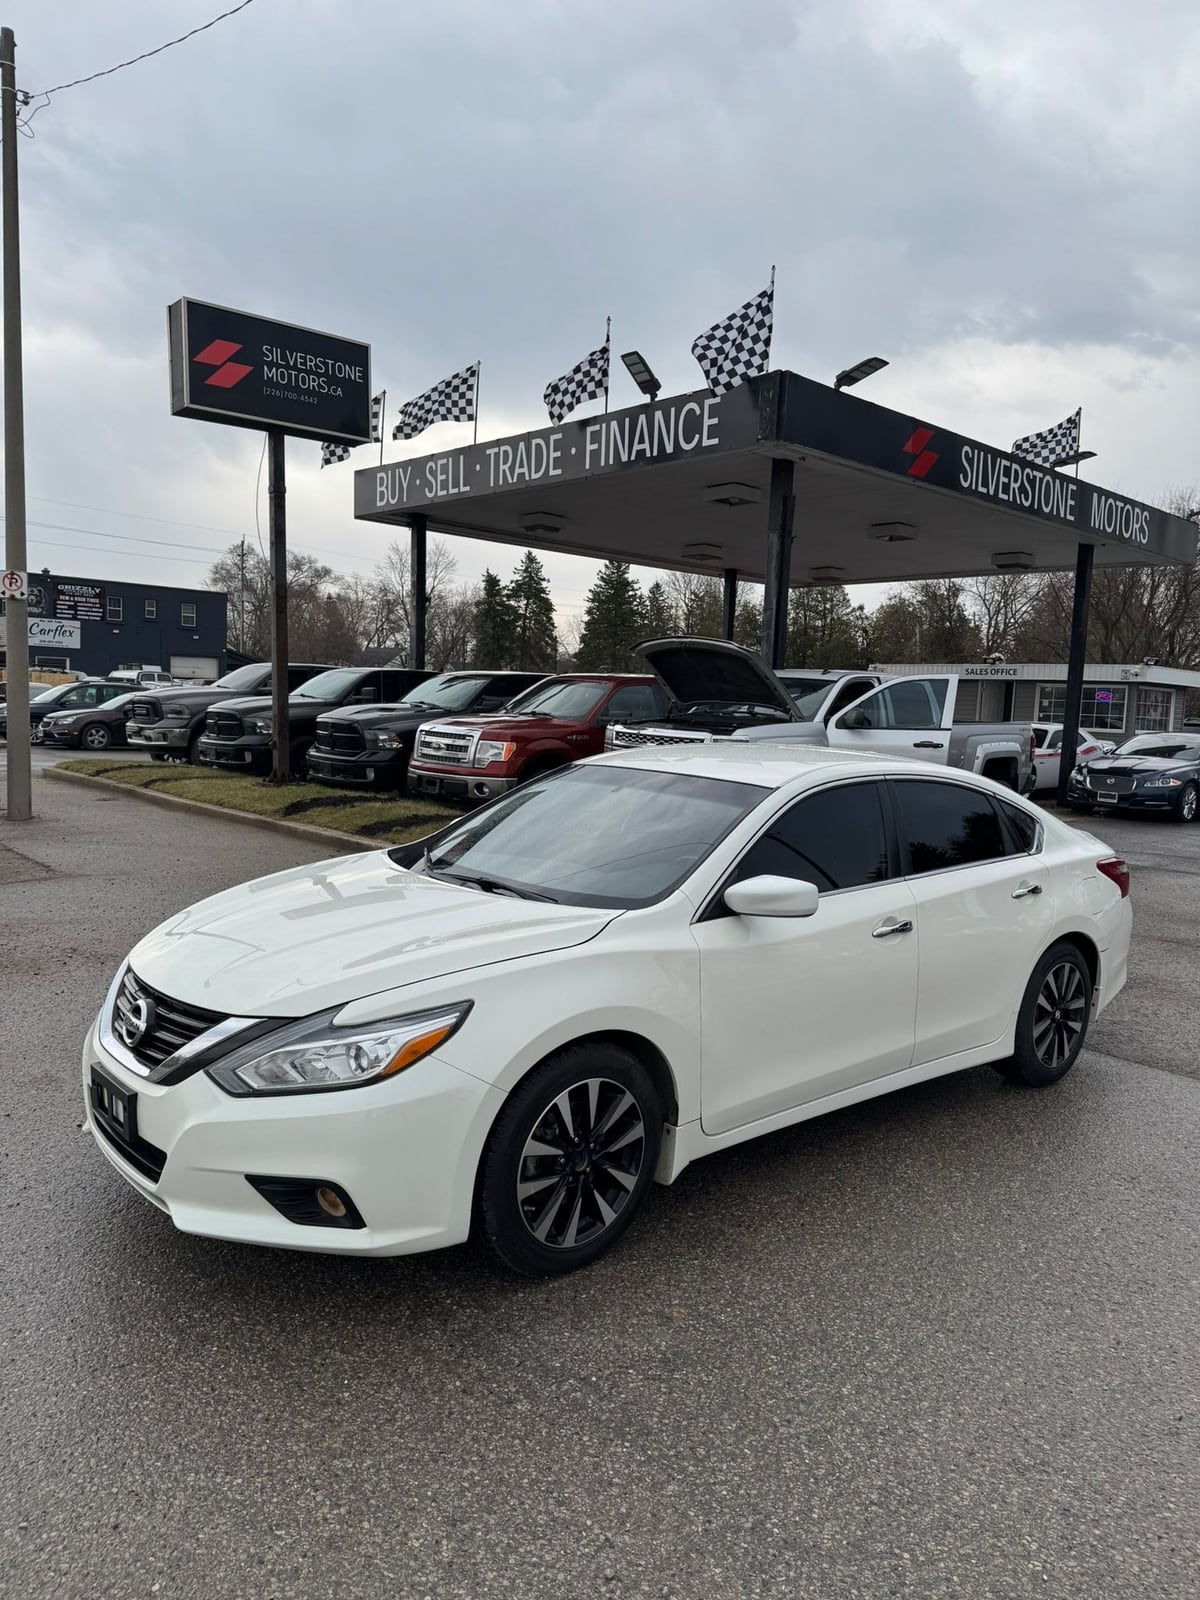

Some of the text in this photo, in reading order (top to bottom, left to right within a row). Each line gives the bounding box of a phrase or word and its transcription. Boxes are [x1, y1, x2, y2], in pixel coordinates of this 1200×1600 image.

[262, 345, 364, 383] SILVERSTONE
[263, 366, 343, 397] MOTORS.CA
[376, 396, 721, 508] BUY SELL TRADE FINANCE
[959, 445, 1150, 545] SILVERSTONE MOTORS
[57, 584, 101, 593] GRIZZLY
[29, 623, 75, 640] Carflex
[964, 667, 1018, 676] SALES OFFICE
